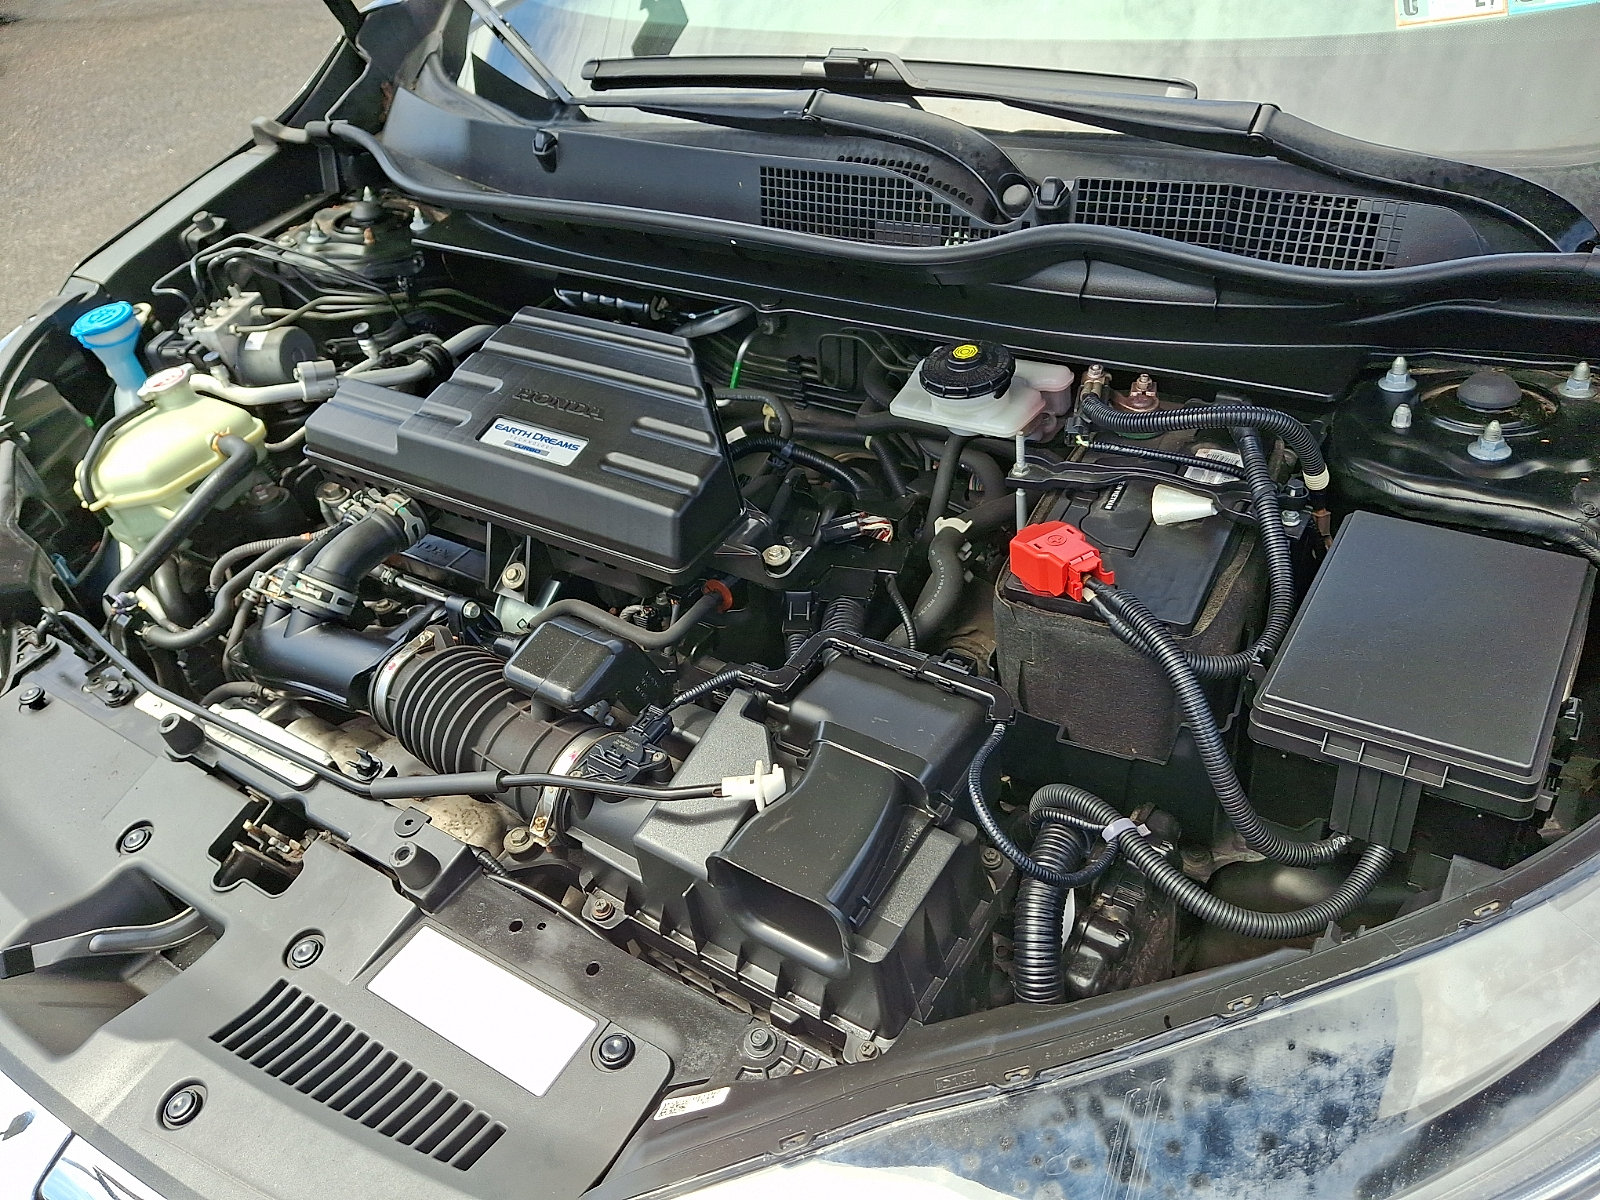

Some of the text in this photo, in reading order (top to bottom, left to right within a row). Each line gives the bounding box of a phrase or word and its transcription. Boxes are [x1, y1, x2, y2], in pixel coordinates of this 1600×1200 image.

[512, 388, 605, 422] HONDA
[494, 423, 581, 452] EARTH DREAMS
[512, 443, 542, 454] TURBO
